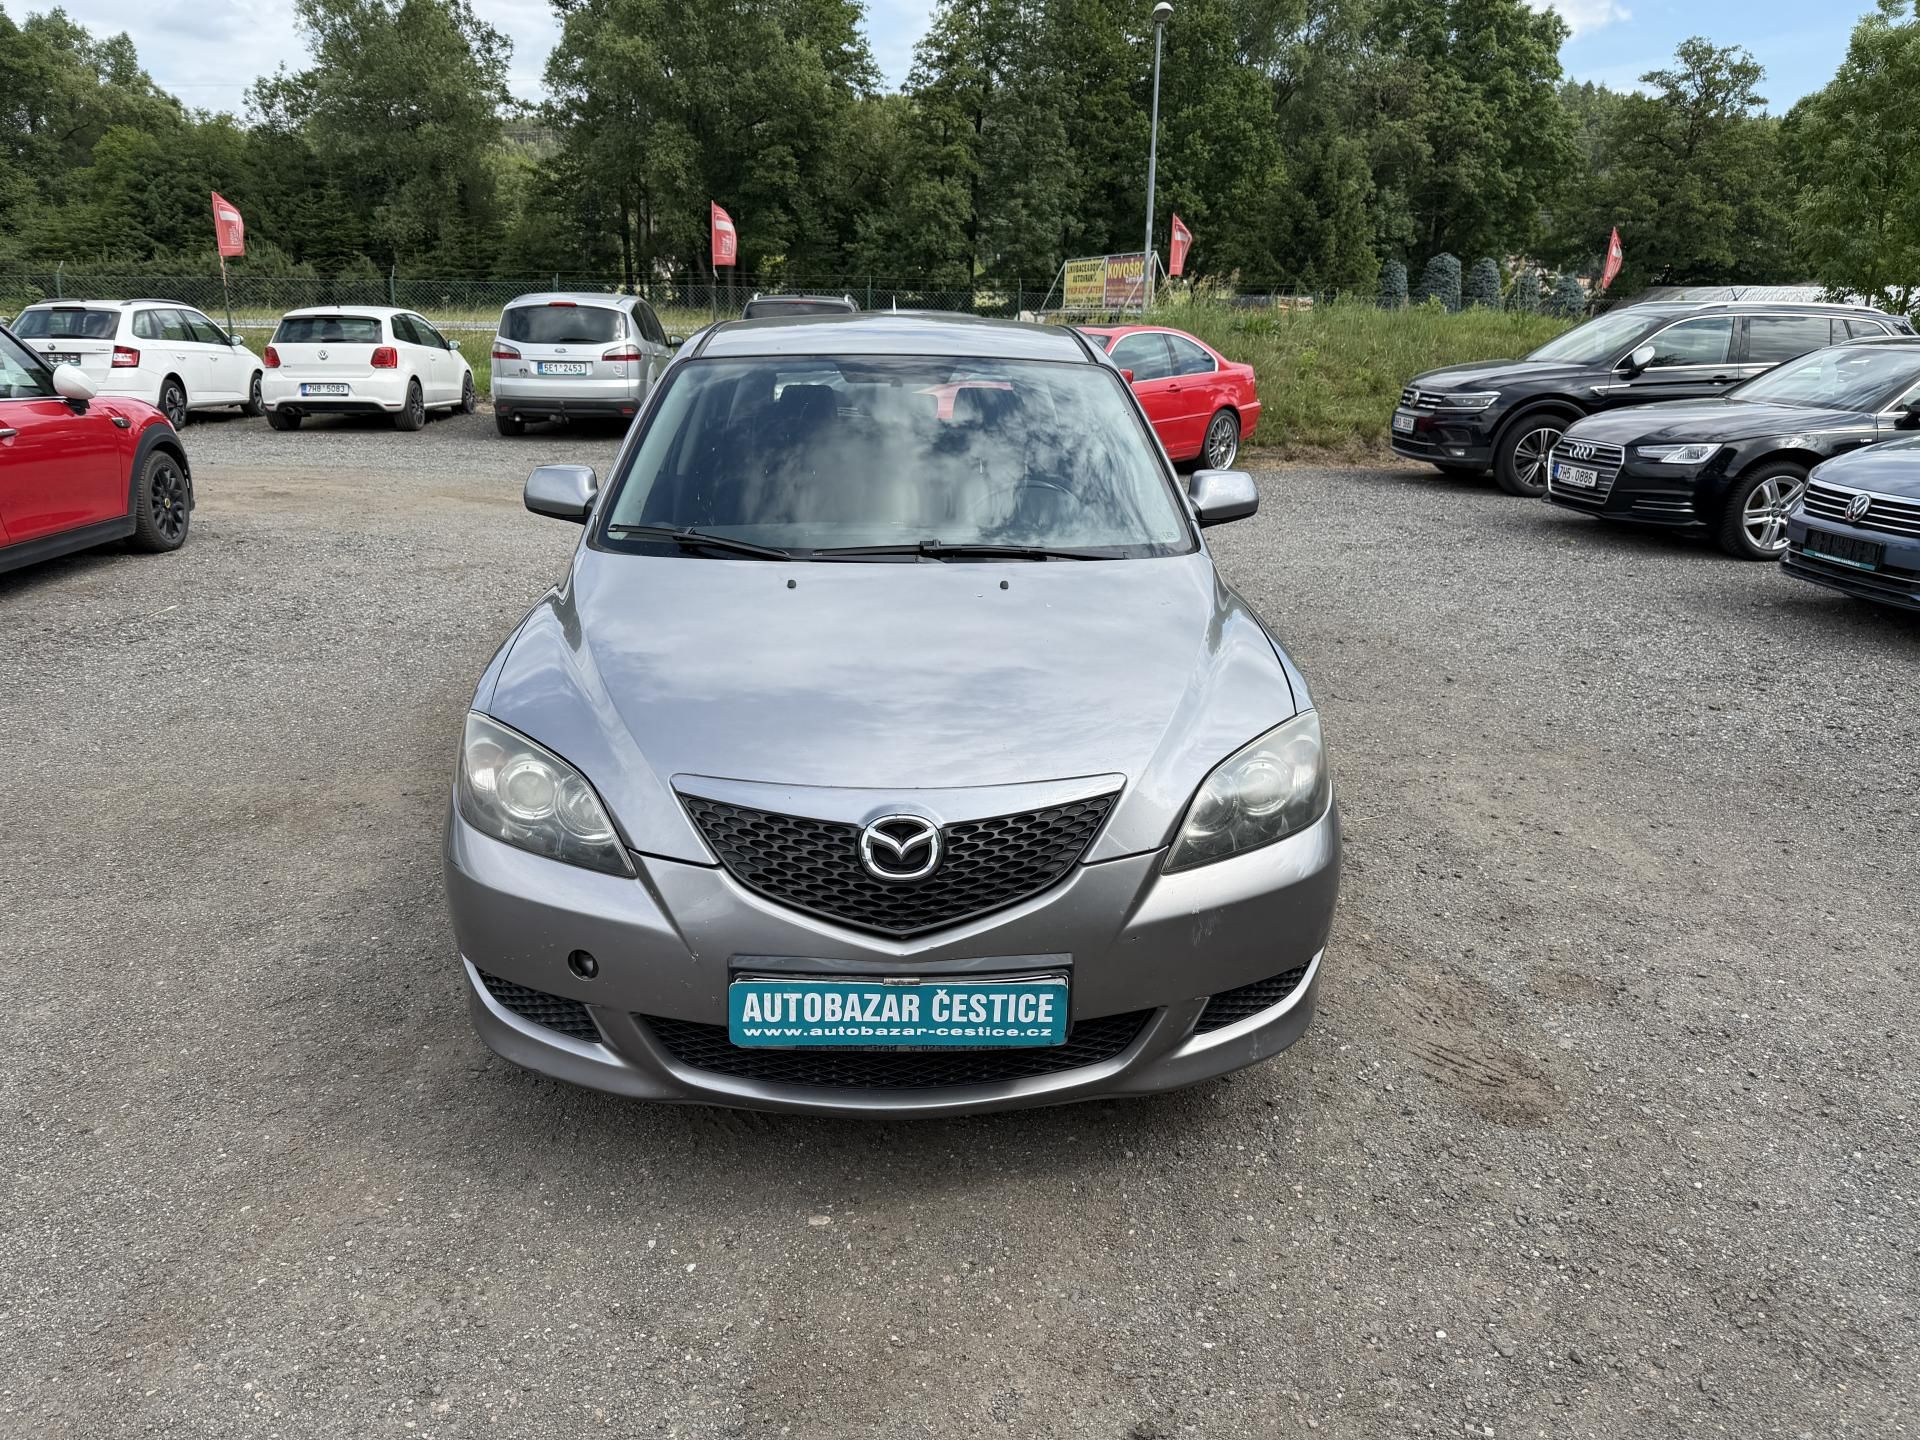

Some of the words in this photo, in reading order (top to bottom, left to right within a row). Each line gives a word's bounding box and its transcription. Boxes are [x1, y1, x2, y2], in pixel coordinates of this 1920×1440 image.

[1107, 258, 1145, 279] KOVOŠRO
[544, 362, 558, 372] 5E1
[564, 362, 583, 373] 2453
[1559, 466, 1571, 480] 7H5
[1575, 470, 1594, 484] 0886
[742, 992, 920, 1023] AUTOBAZAR
[931, 989, 1054, 1023] ČESTICE
[743, 1026, 1053, 1037] www.autobazar-cestice.cz
